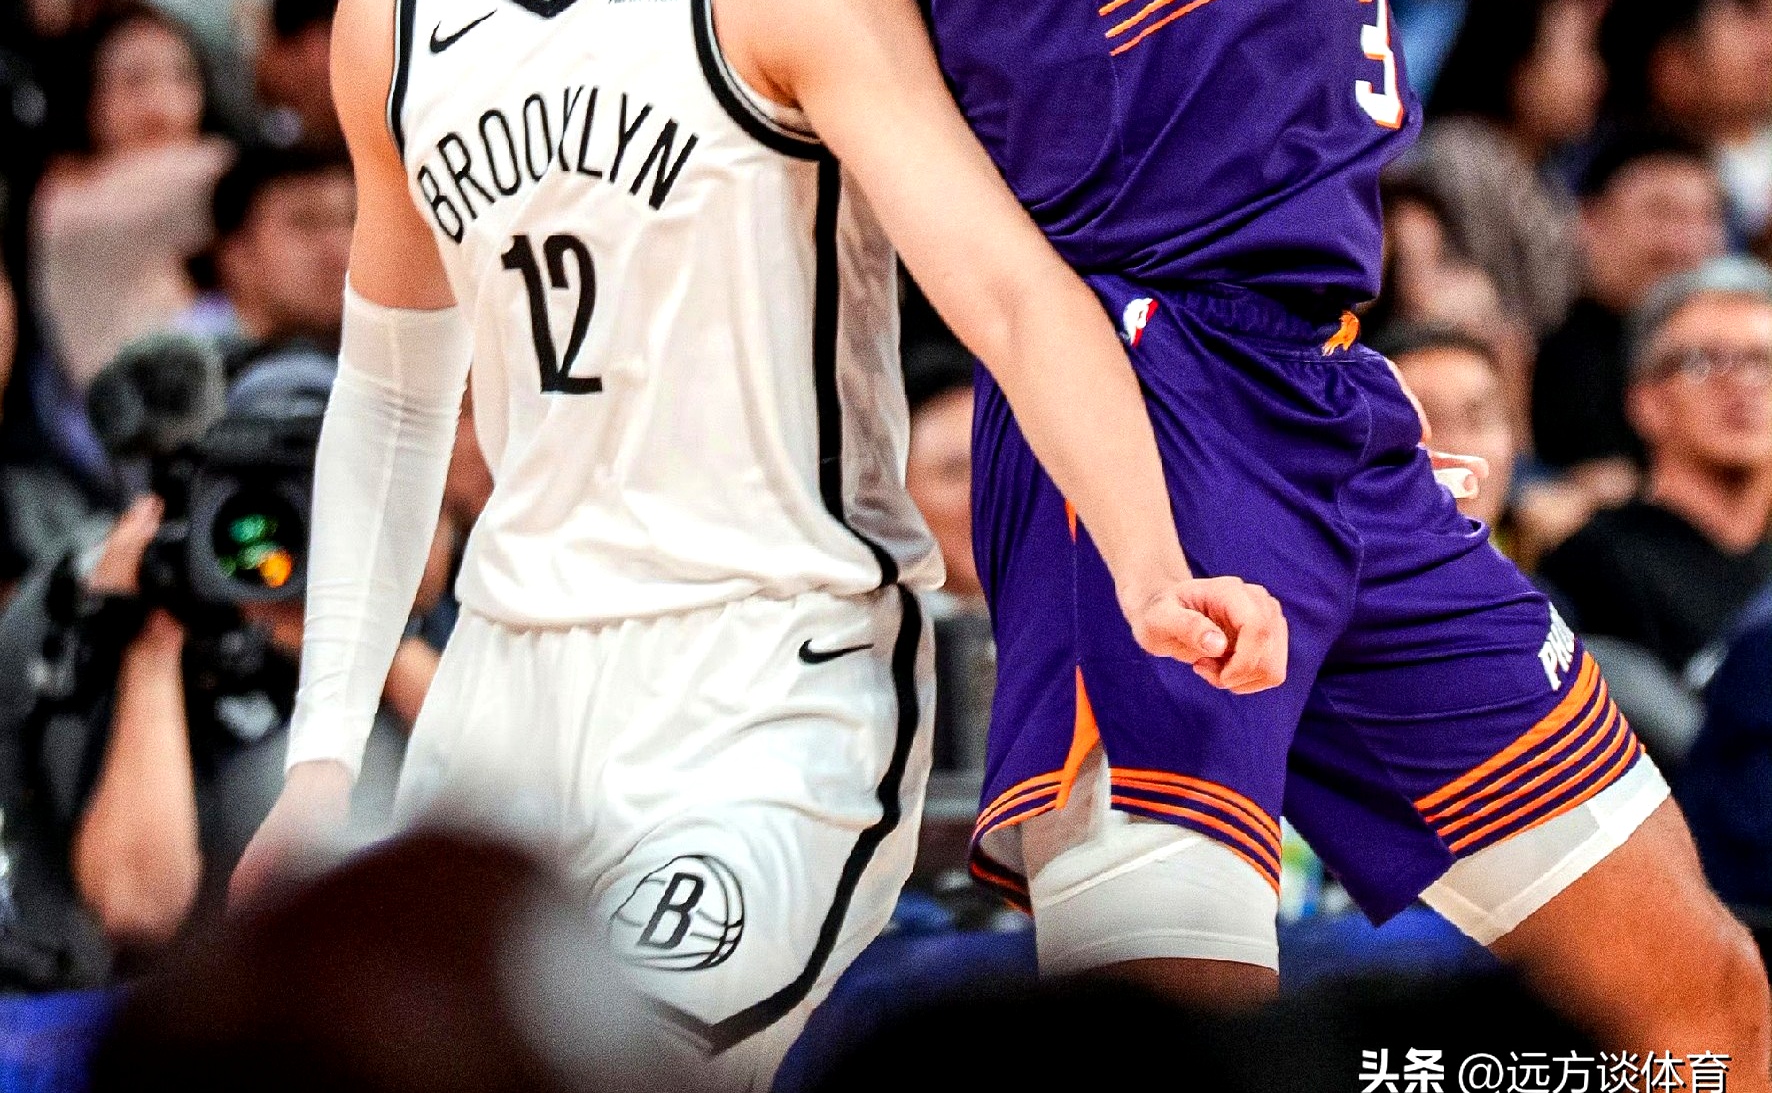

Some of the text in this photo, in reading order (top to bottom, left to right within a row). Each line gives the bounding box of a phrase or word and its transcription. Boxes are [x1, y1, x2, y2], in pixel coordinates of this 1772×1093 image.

[417, 85, 699, 245] BROOKLYN
[501, 234, 603, 394] 12
[636, 872, 705, 950] B
